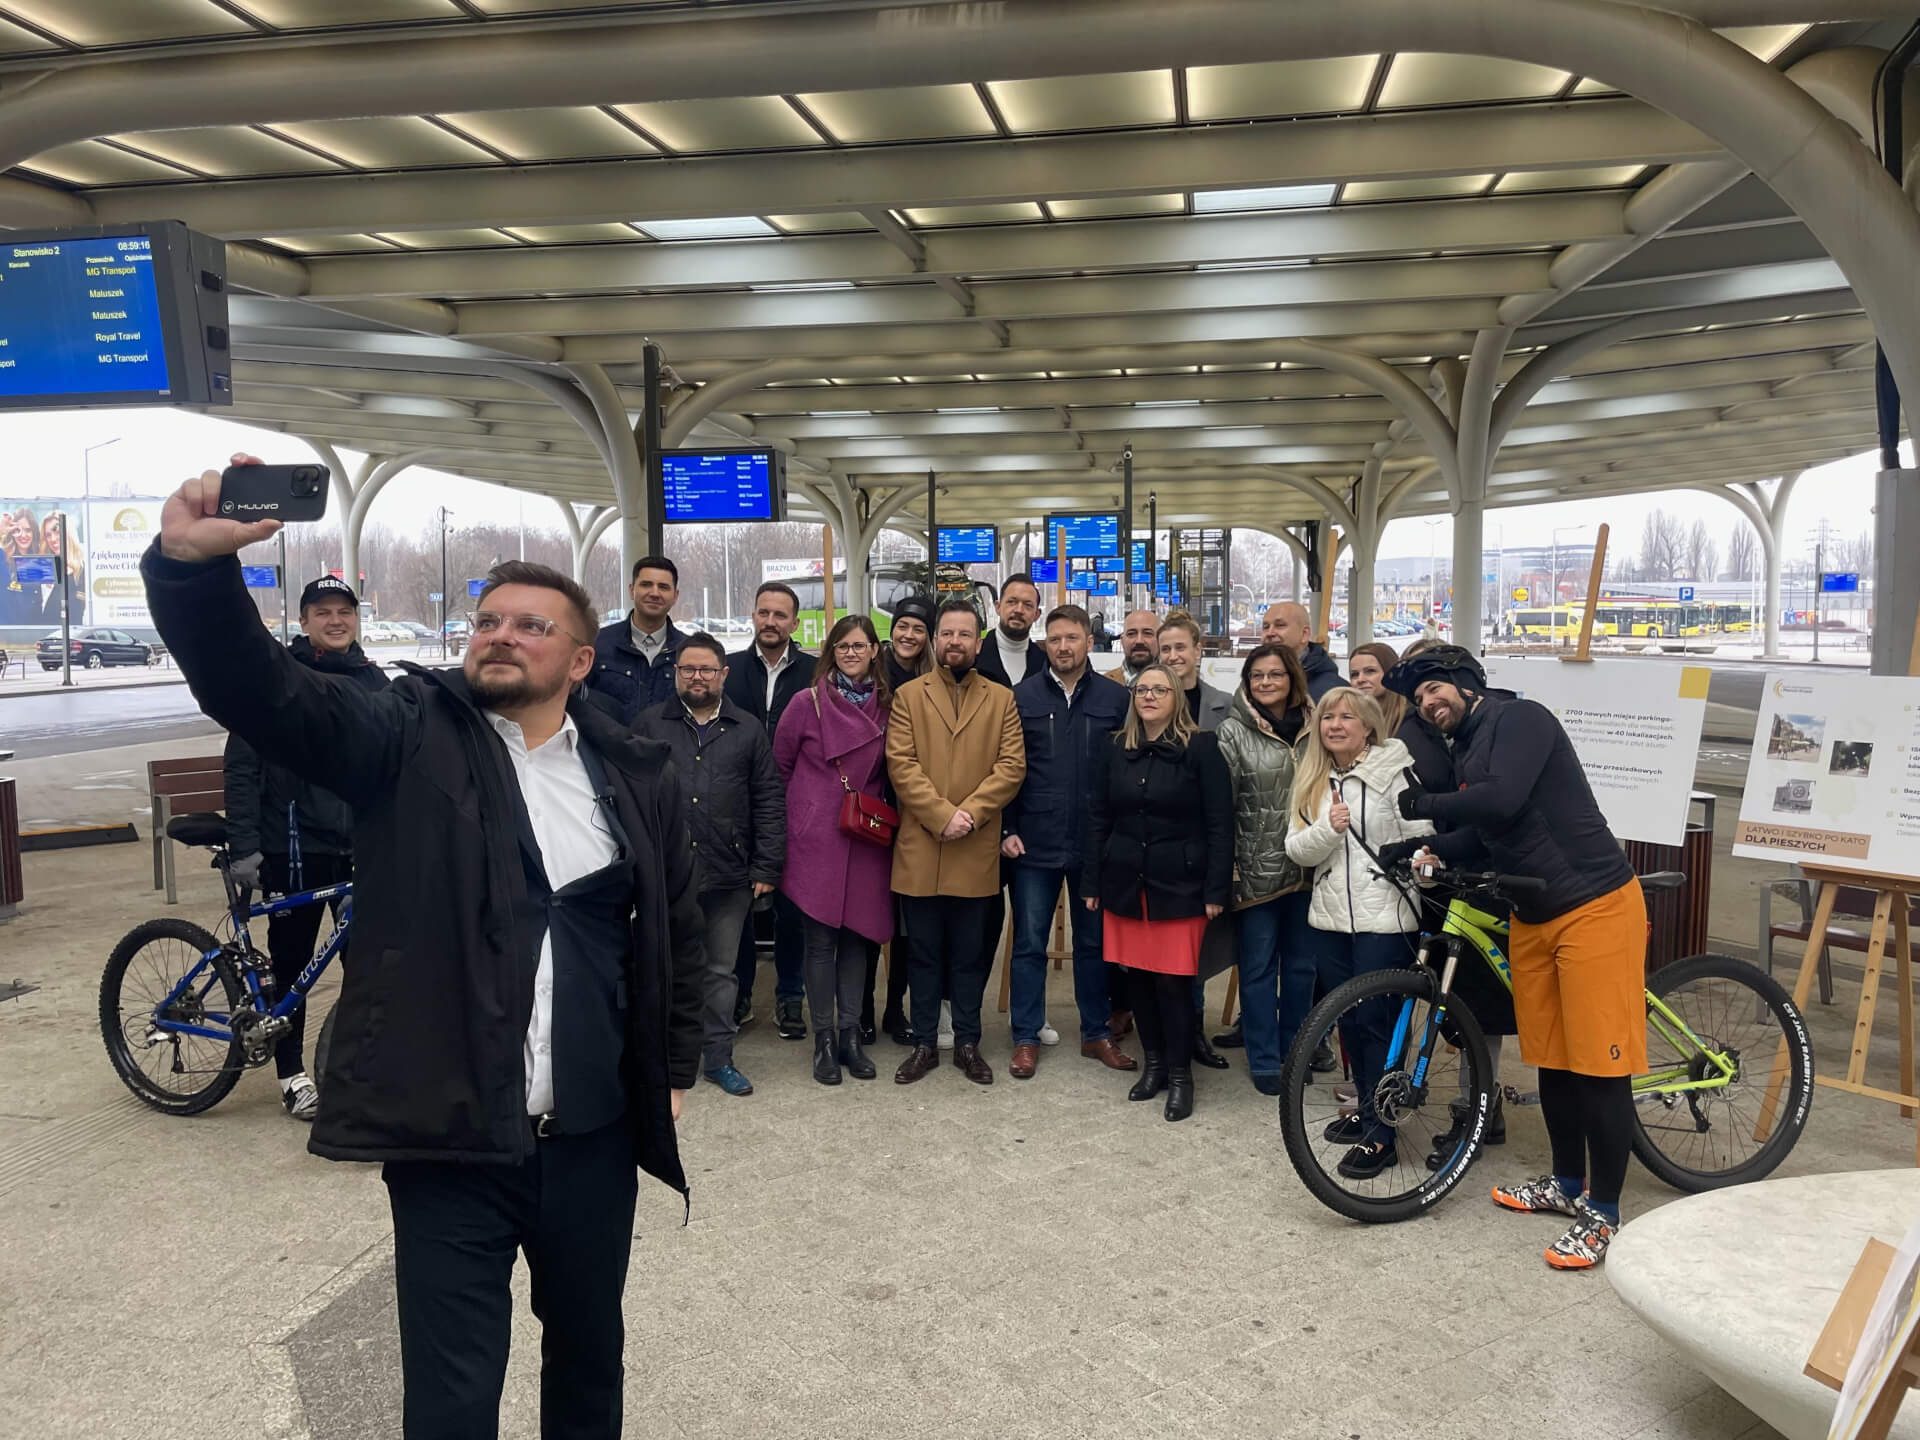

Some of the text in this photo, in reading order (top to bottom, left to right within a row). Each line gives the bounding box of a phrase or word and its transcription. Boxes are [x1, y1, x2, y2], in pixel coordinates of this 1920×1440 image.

[14, 246, 60, 258] Stanowisko 2
[86, 266, 136, 276] MG Transport
[90, 288, 124, 298] Matuszek
[92, 310, 127, 320] Matuszek
[96, 332, 141, 344] Royal Travel
[98, 354, 148, 364] MG Transport
[766, 565, 797, 573] BRAZYLIA
[1682, 588, 1691, 600] P
[1613, 713, 1636, 721] miejsc
[1626, 732, 1673, 740] lokalizacjach
[1603, 764, 1663, 776] przesiadkowych
[1745, 834, 1826, 851] DLA PIESZYCH
[1786, 830, 1822, 840] SZYBKO
[1824, 834, 1838, 842] PO
[1840, 836, 1866, 846] KATO
[1792, 1019, 1806, 1044] JACK
[1802, 1045, 1811, 1085] RABBIT
[1472, 1114, 1486, 1144] JACK
[1452, 1144, 1477, 1180] RABBIT
